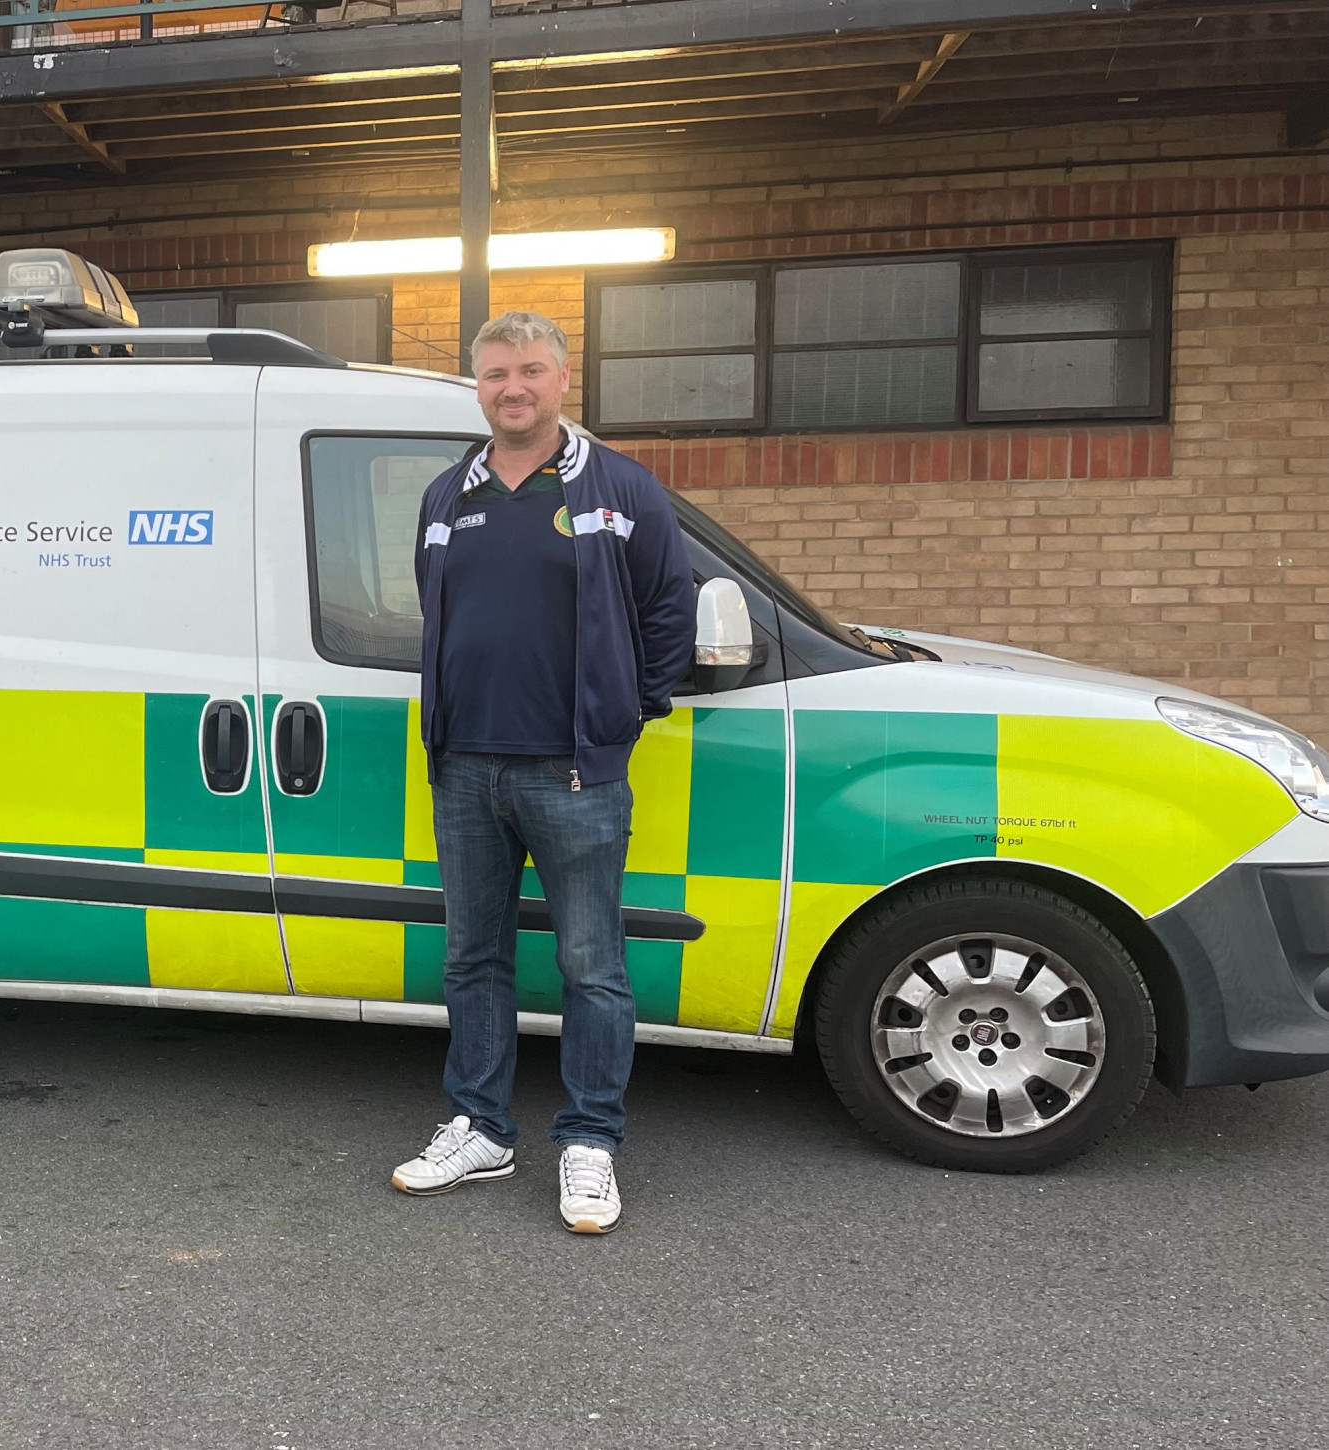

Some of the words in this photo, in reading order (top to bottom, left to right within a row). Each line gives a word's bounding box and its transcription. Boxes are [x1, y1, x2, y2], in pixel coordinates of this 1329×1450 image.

[26, 520, 113, 542] Service
[130, 513, 211, 543] NHS
[39, 554, 70, 567] NHS
[75, 554, 111, 567] Trust
[924, 814, 963, 824] WHEEL
[966, 816, 988, 825] NUT
[992, 816, 1037, 827] TORQUE
[1069, 819, 1077, 828] ft
[974, 834, 988, 843] TP
[990, 836, 1005, 844] 40
[1008, 837, 1023, 847] psi
